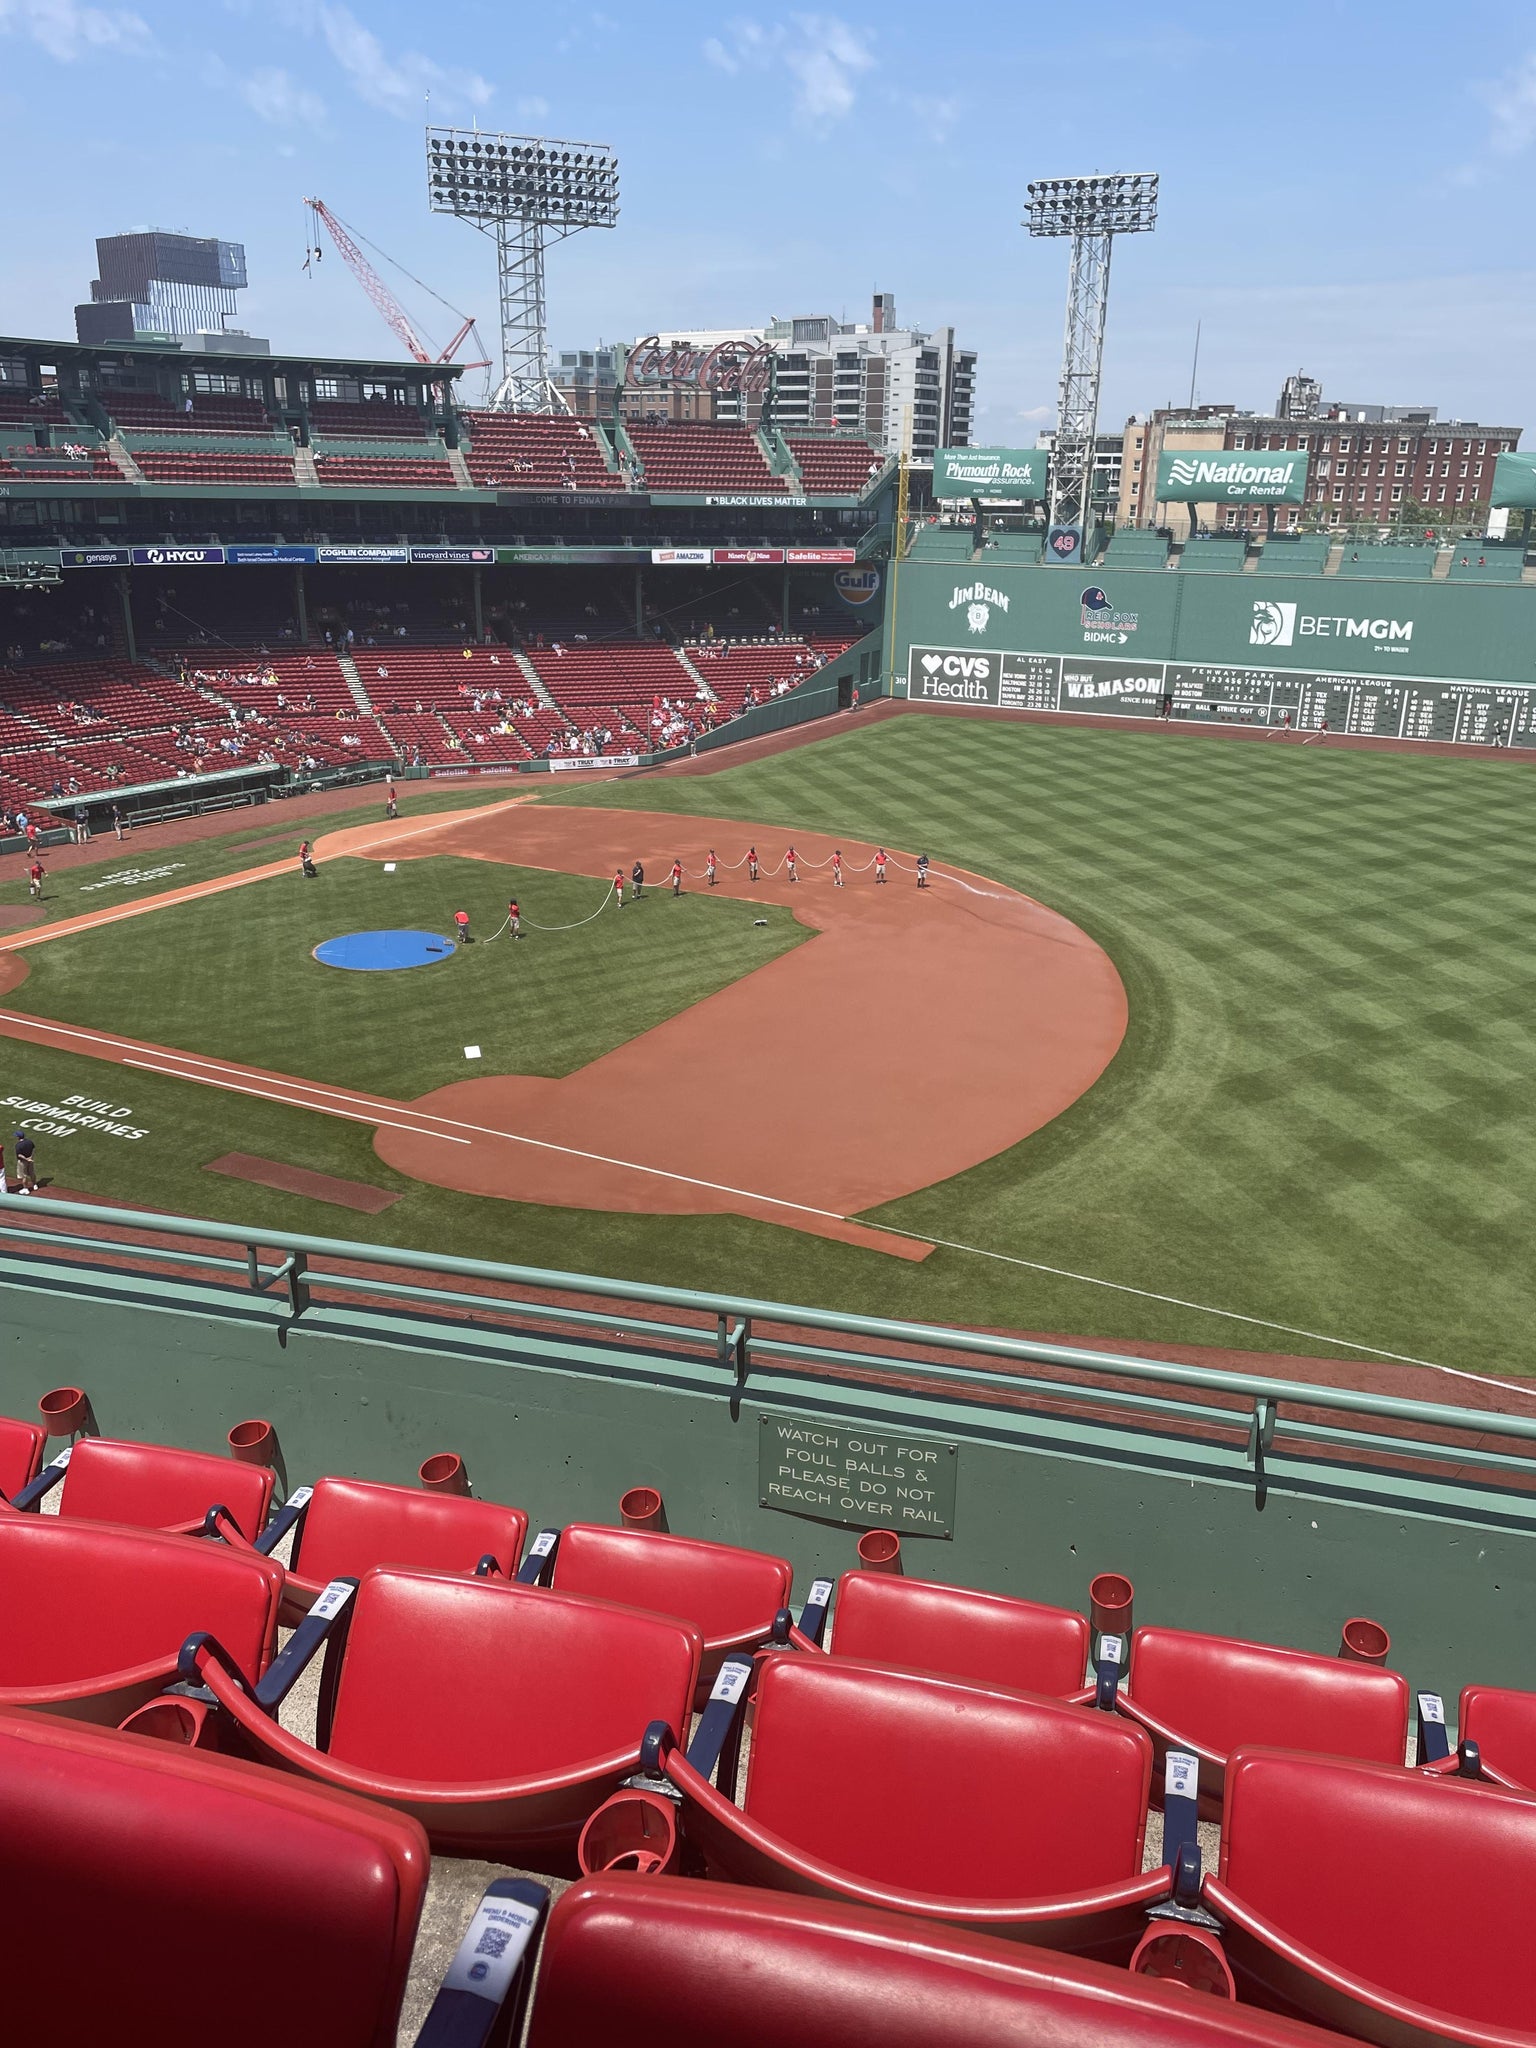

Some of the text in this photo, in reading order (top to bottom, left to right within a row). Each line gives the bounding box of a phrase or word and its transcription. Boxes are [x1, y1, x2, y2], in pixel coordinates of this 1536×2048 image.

[946, 463, 1032, 478] Plymouth Rock
[1228, 486, 1286, 495] Car Rental
[560, 496, 571, 504] TO
[574, 496, 607, 505] FENWAY
[720, 496, 807, 506] BLACK LIVES MATTER
[1054, 536, 1075, 551] 49
[86, 554, 118, 563] genasys
[166, 550, 206, 561] HYCU
[414, 551, 470, 560] vineyard vines
[728, 552, 770, 561] Ninety Nine
[788, 552, 821, 560] Safelite
[837, 572, 877, 589] Gulf
[949, 582, 1011, 613] JIM BEAM
[1086, 612, 1139, 623] RED SOX
[1084, 621, 1137, 631] SCHOLARS
[1299, 616, 1414, 641] BETMGM
[1084, 632, 1117, 644] BIDMC
[942, 656, 990, 679] CVS
[1192, 668, 1237, 676] FENWAY
[895, 676, 907, 685] 310
[1316, 676, 1392, 687] AMERICAN LEAGUE
[922, 676, 989, 700] Health
[1450, 686, 1529, 697] NATIONAL LEAGUE
[480, 766, 513, 774] Safelite
[60, 1095, 132, 1118] BUILD
[0, 1096, 150, 1139] SUBMARINES
[778, 1426, 938, 1464] WATCH OUT FOR
[786, 1448, 928, 1482] FOUL BALLS &
[779, 1466, 935, 1502] PLEASE DO NOT
[768, 1483, 945, 1523] REACH OVER RAIL
